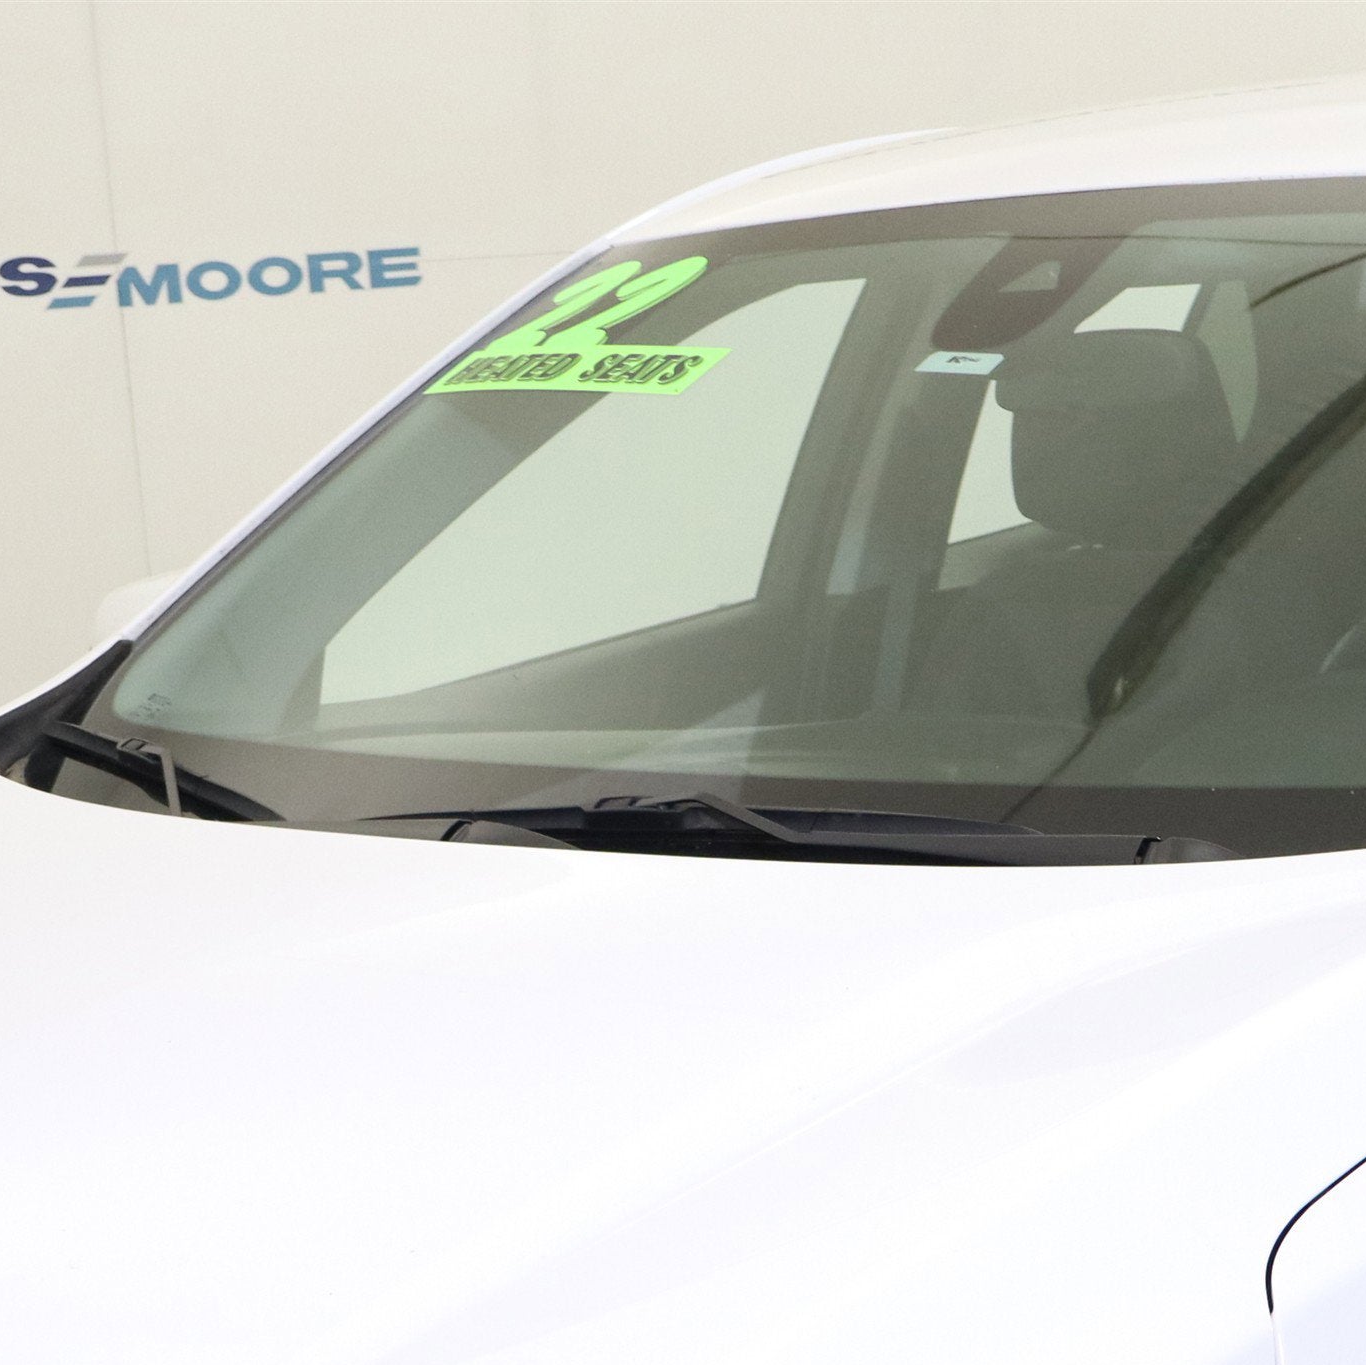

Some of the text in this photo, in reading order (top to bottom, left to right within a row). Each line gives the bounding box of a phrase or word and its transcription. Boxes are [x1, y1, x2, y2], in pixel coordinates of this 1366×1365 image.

[116, 246, 422, 307] MOORE
[485, 256, 709, 347] 22
[443, 353, 704, 386] HEATED SEATS
